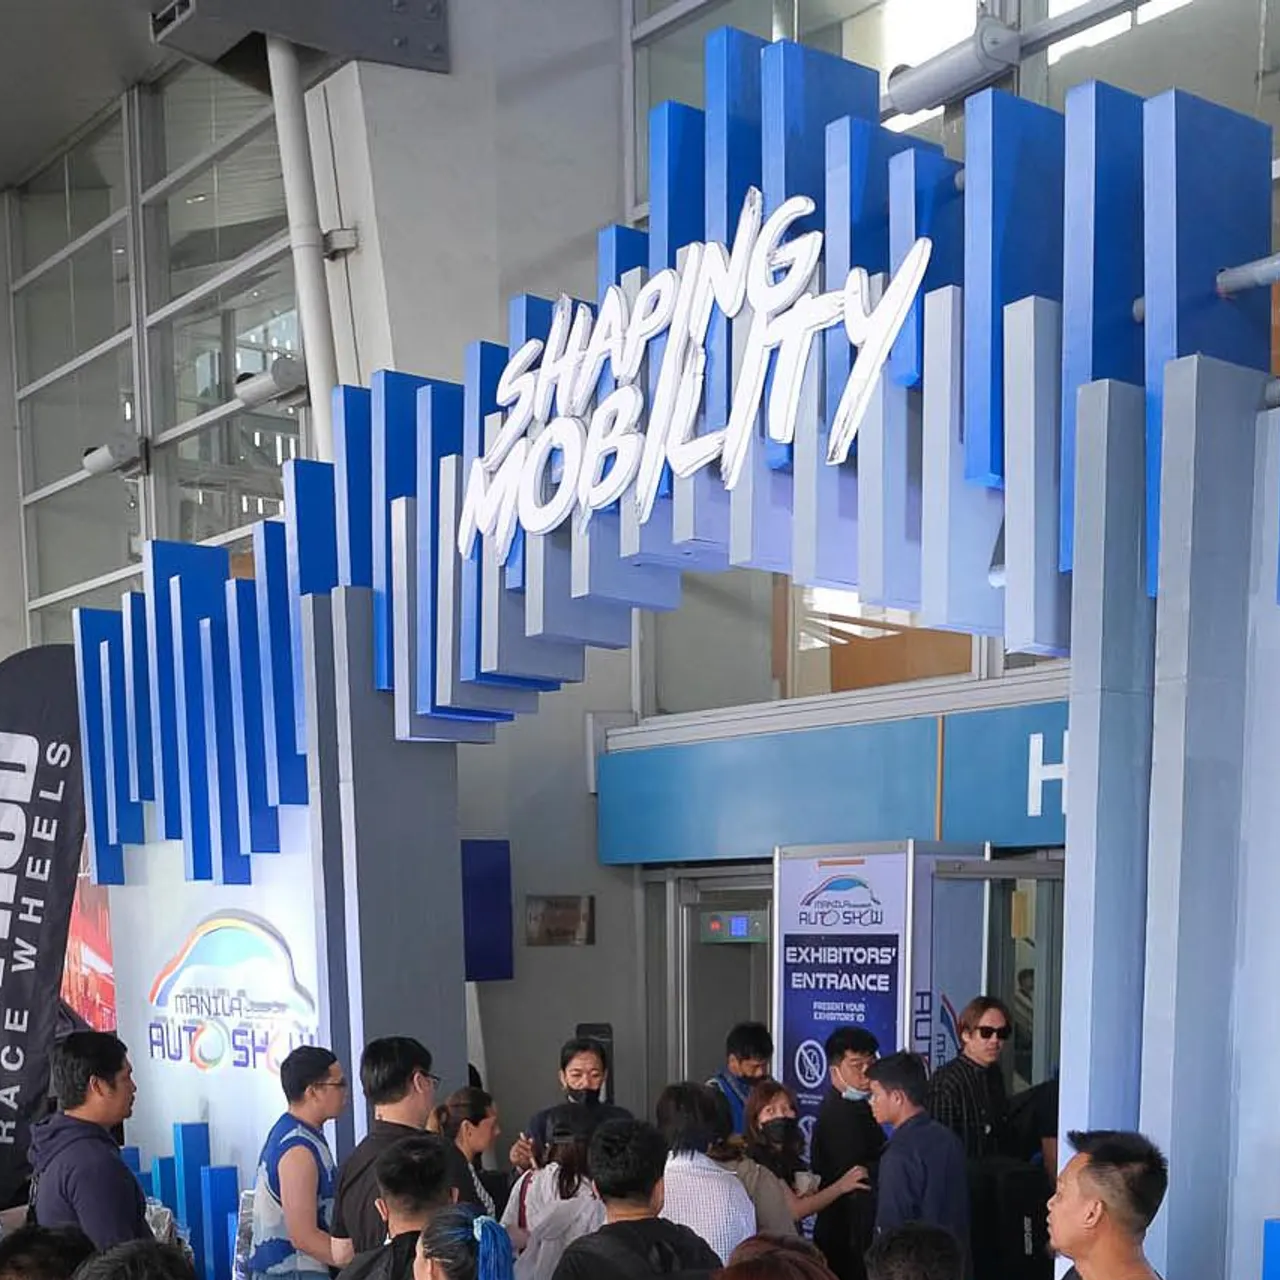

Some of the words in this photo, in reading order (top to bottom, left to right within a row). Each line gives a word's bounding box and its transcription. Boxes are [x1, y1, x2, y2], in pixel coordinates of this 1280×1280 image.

[480, 185, 824, 473] SHAPING
[459, 236, 933, 566] MOBILITY
[12, 740, 72, 972] WHEELS
[799, 909, 840, 926] AUTO
[842, 909, 883, 926] SHOW
[785, 946, 897, 965] EXHIBITORS'
[791, 972, 890, 992] ENTRANCE
[174, 994, 243, 1018] MANILA
[915, 991, 933, 1066] AUT
[148, 1019, 228, 1072] AUTO
